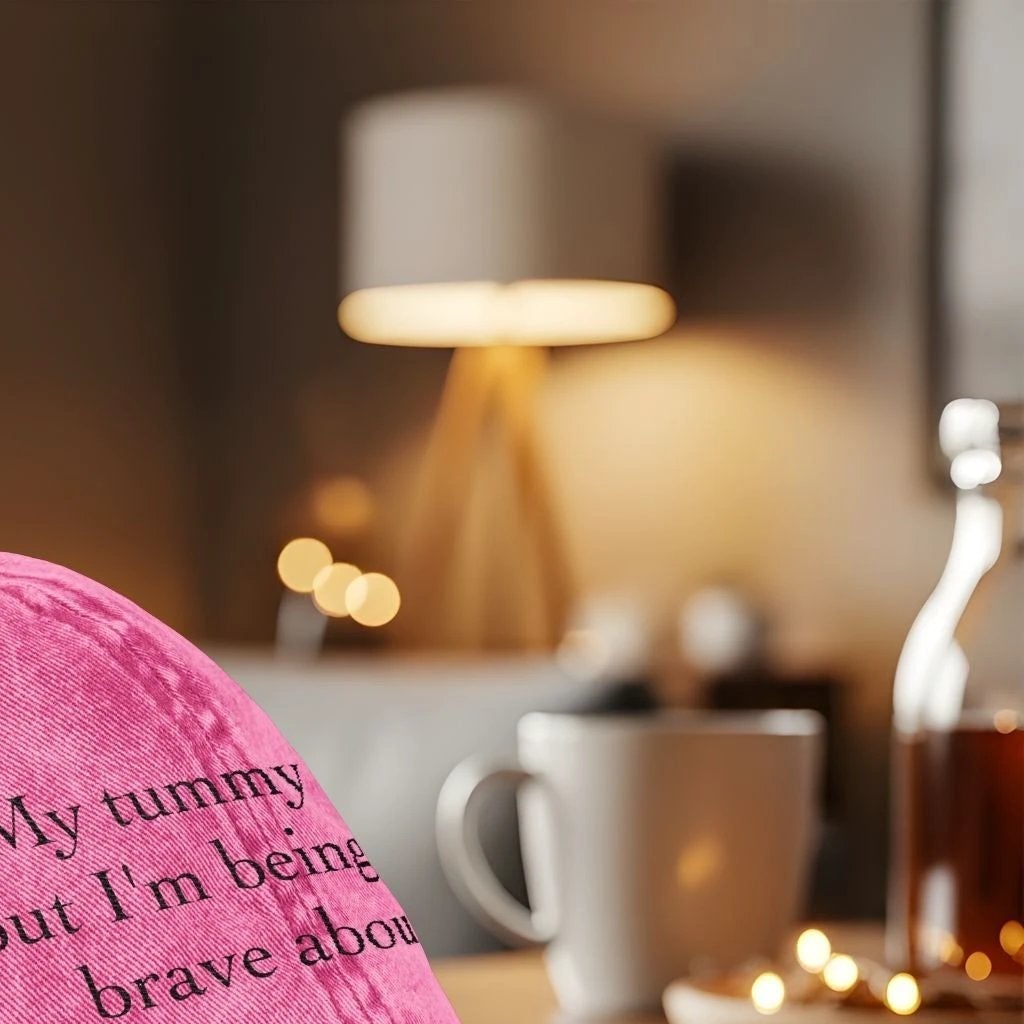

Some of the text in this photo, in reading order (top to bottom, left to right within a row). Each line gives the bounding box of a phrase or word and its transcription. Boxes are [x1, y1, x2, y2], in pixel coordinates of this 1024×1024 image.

[101, 763, 305, 828] tummy
[91, 864, 213, 923] I'm
[208, 827, 380, 890] being
[76, 944, 278, 1020] brave
